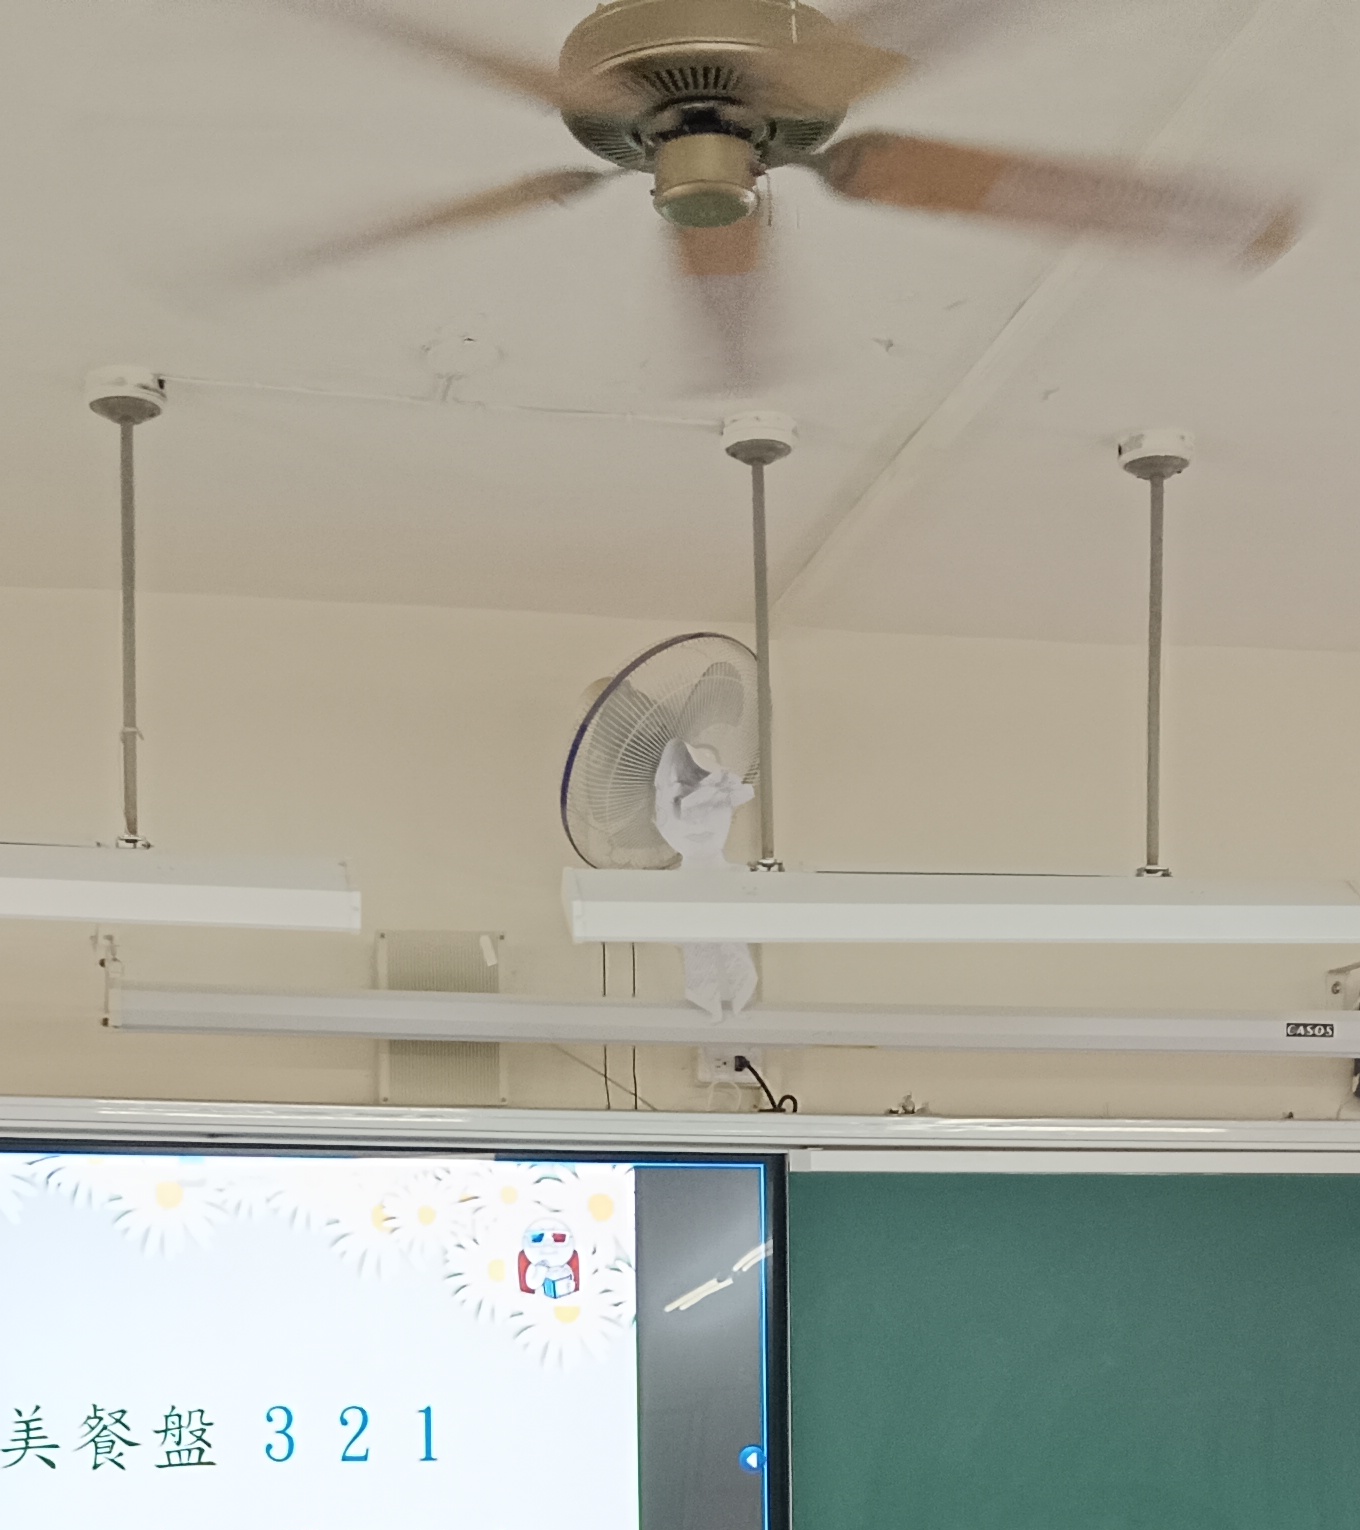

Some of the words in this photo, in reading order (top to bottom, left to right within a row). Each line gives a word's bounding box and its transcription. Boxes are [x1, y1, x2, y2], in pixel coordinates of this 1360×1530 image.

[1287, 1024, 1333, 1036] CASOS
[264, 1405, 296, 1463] 3
[340, 1405, 371, 1462] 2
[416, 1405, 439, 1462] 1
